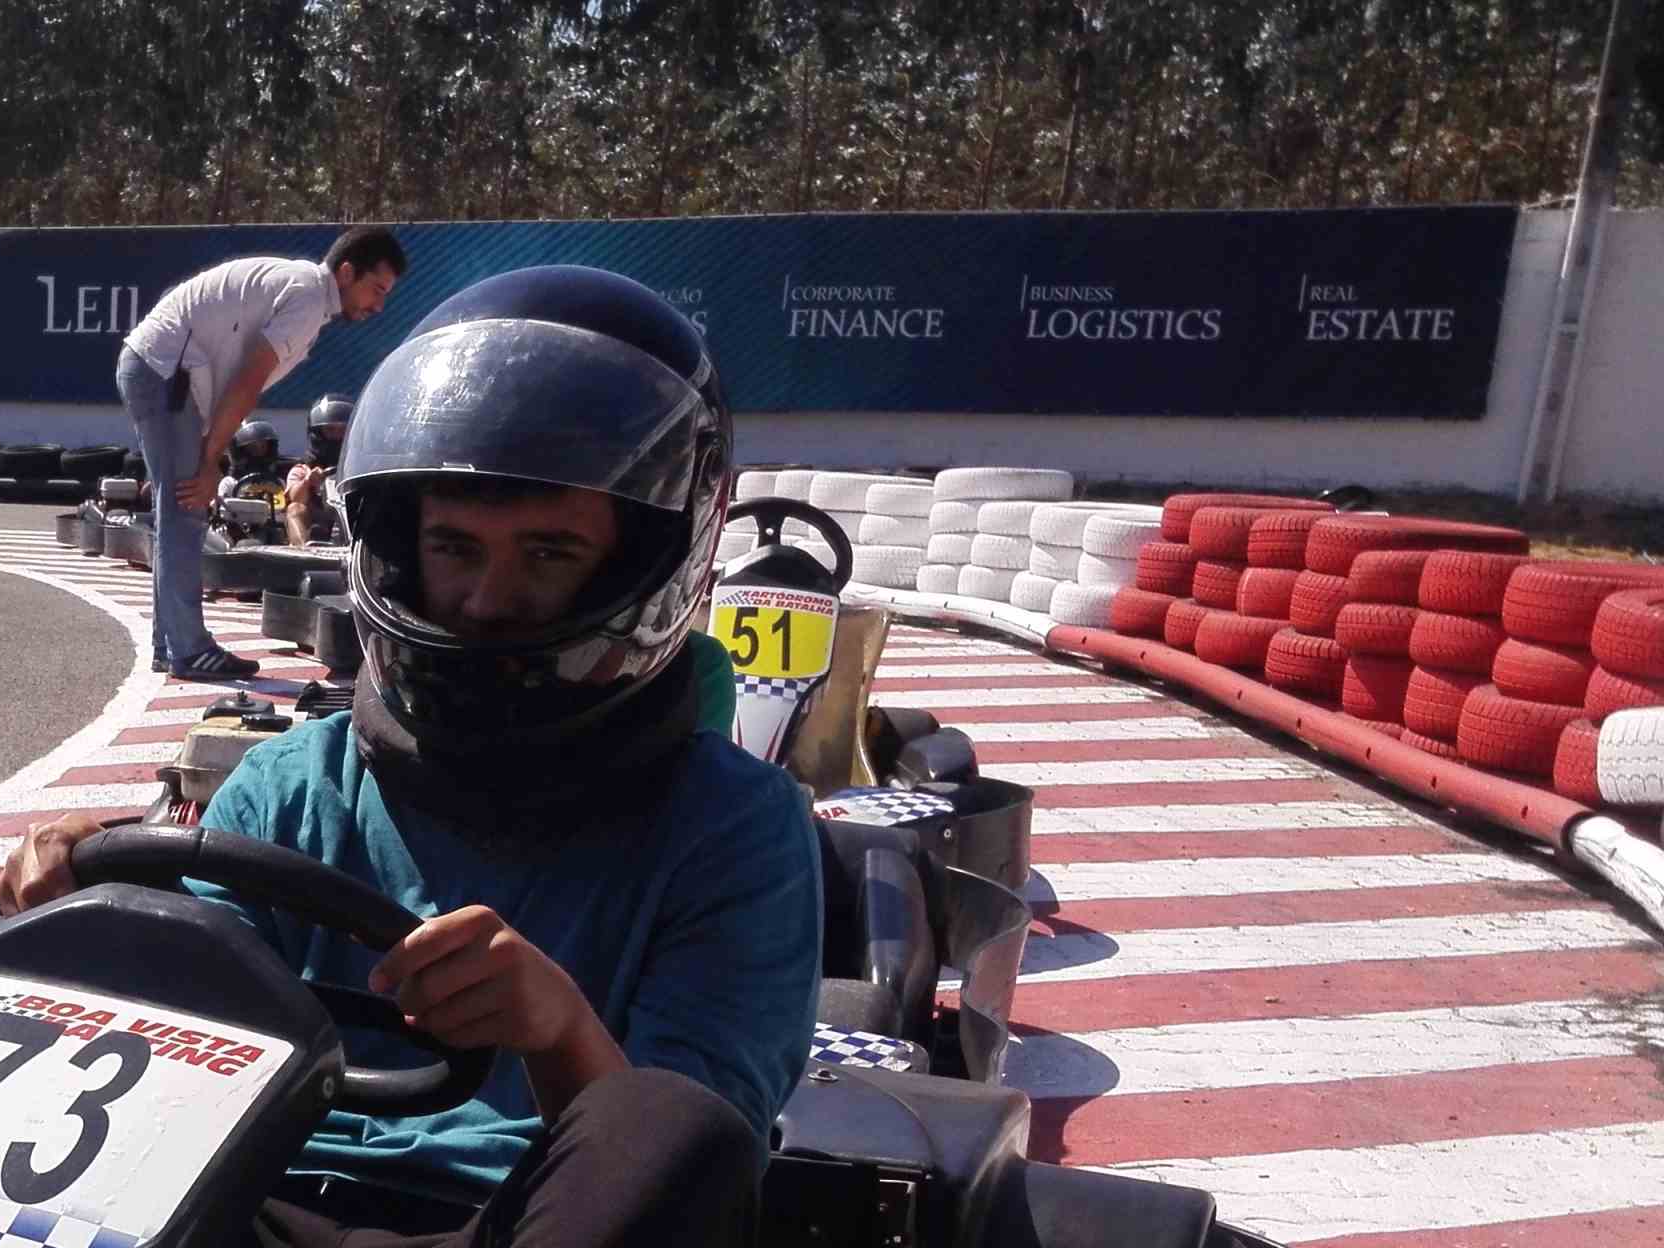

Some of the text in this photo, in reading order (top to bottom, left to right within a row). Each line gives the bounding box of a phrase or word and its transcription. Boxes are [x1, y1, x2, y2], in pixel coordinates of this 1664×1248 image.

[790, 285, 896, 302] CORPORATE
[1030, 285, 1115, 302] BUSINESS
[1309, 284, 1358, 302] REAL
[787, 308, 945, 339] FINANCE
[1026, 308, 1223, 341] LOGISTICS
[1306, 308, 1455, 341] ESTATE
[730, 606, 791, 671] 51
[16, 995, 266, 1064] BOA VISTA
